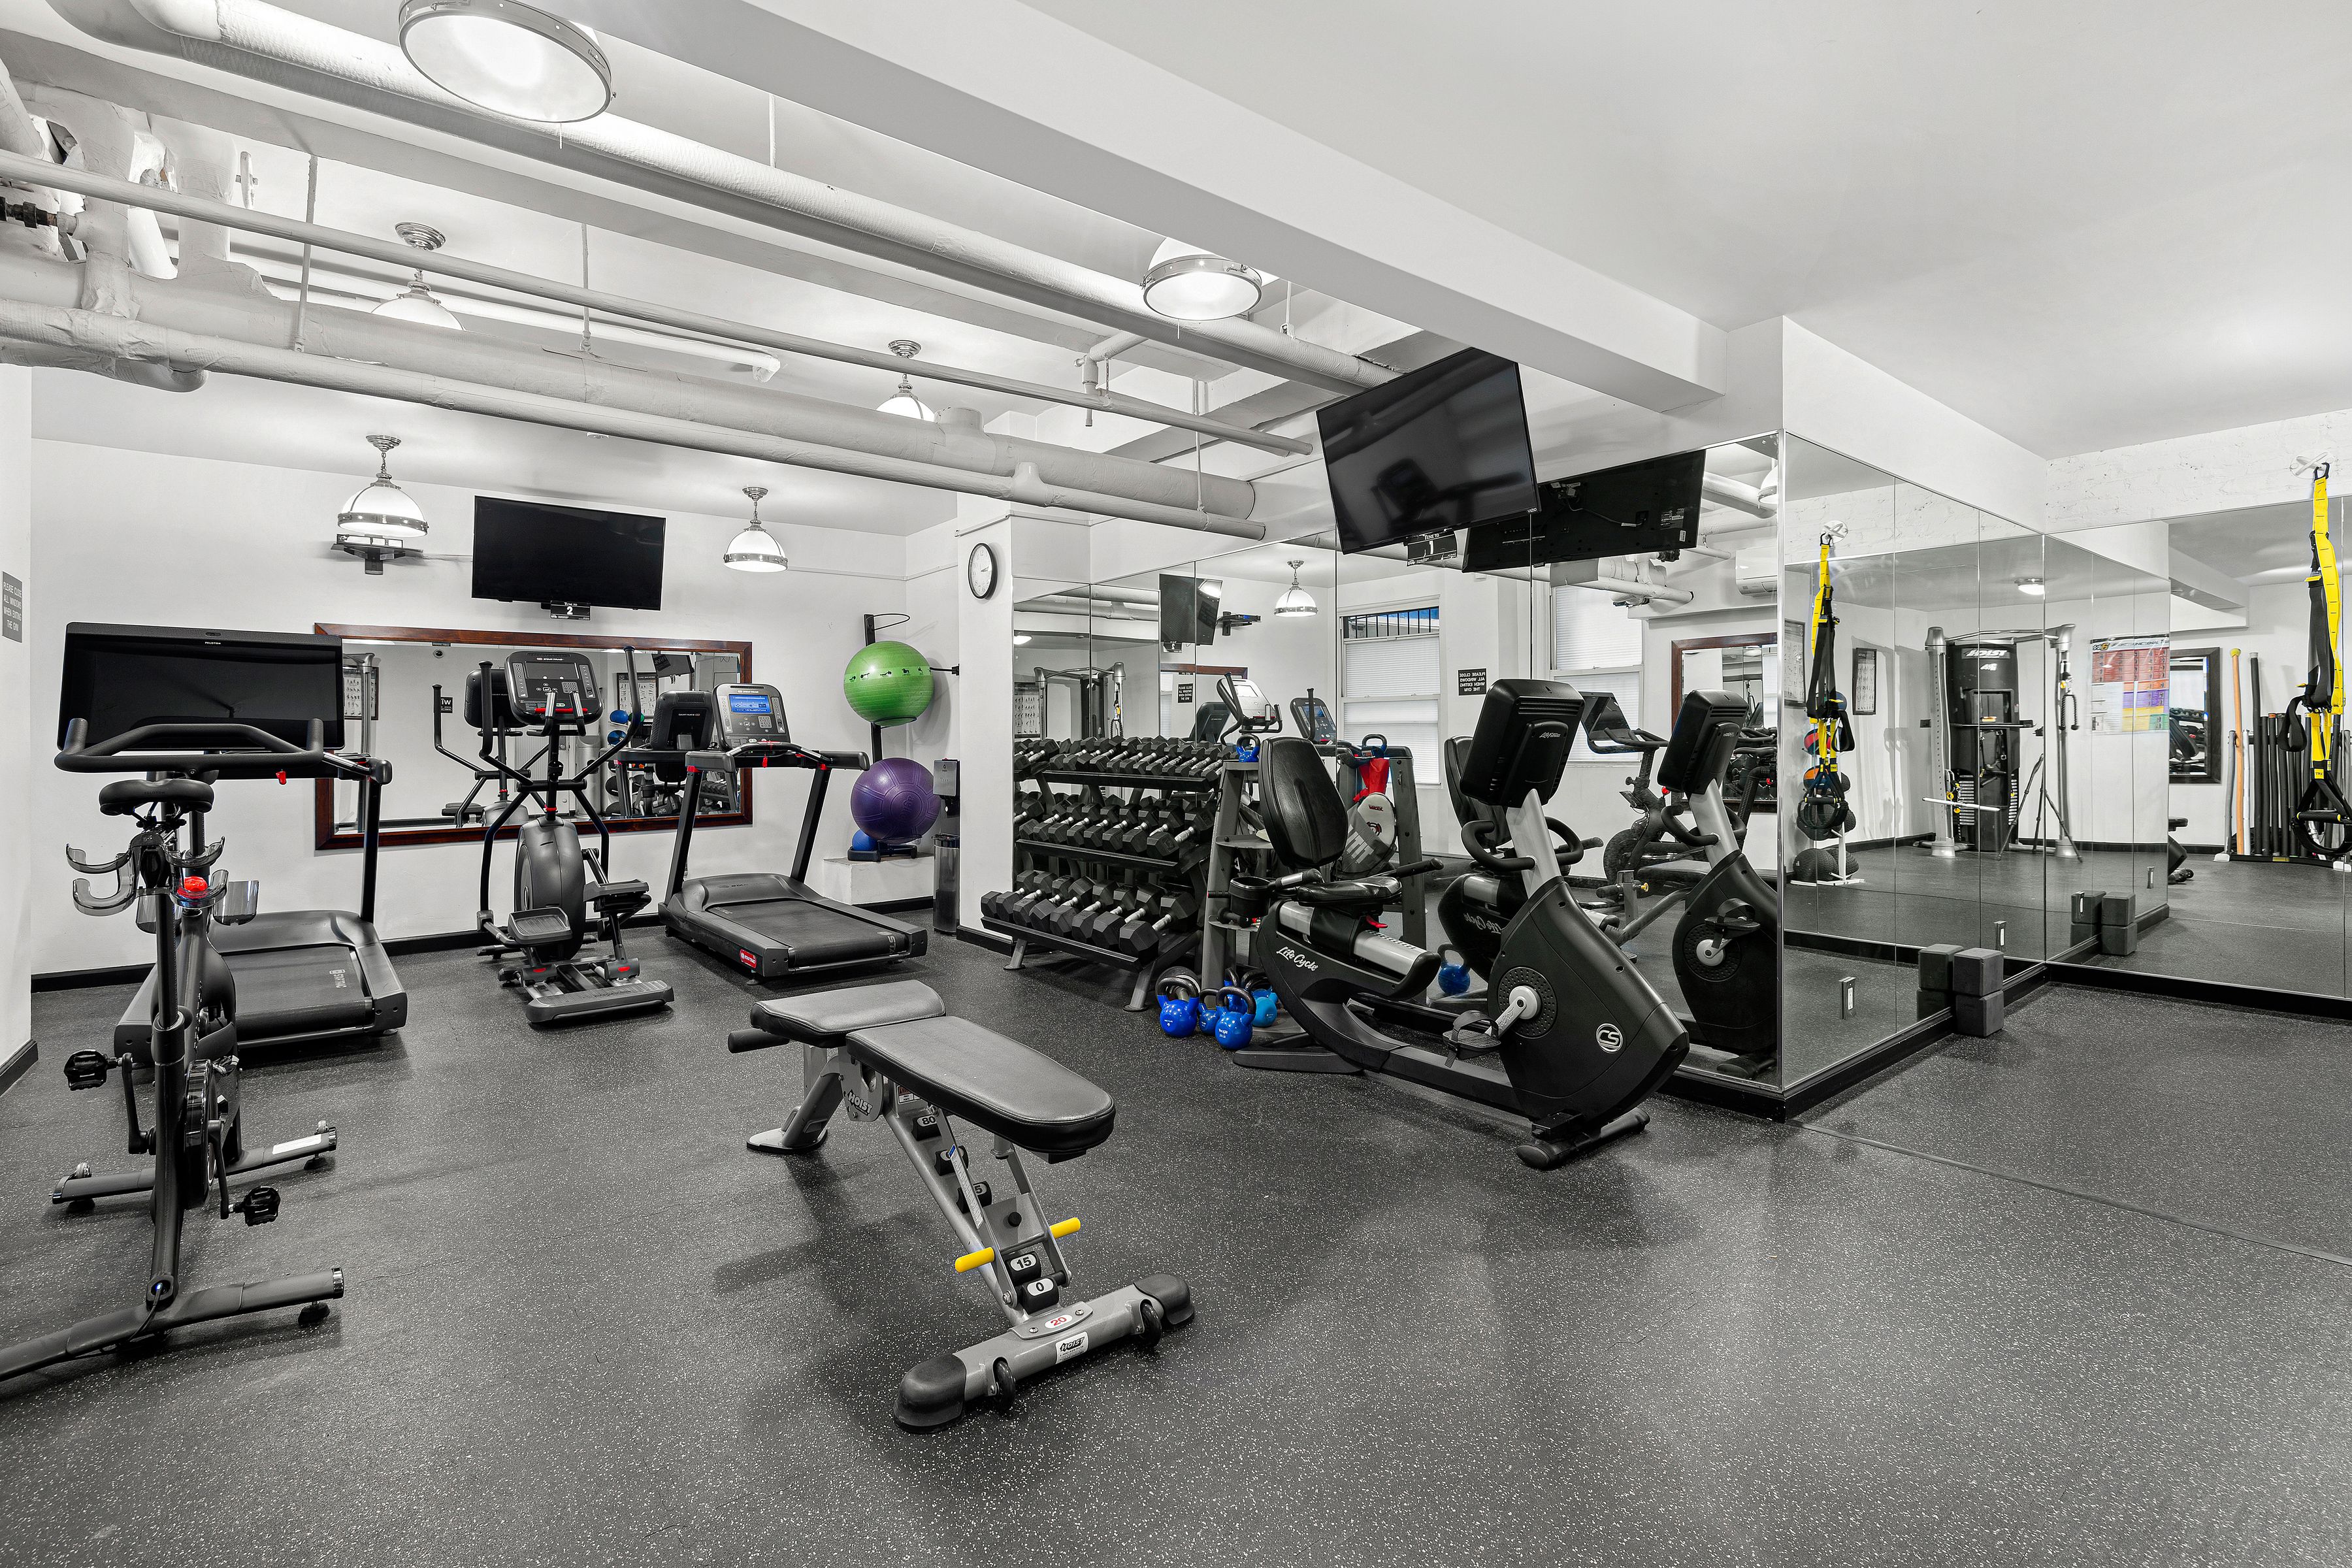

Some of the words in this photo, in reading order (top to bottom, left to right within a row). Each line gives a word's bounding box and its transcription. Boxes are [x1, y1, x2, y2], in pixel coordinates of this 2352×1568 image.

[1429, 540, 1433, 555] 1
[3, 581, 13, 594] PLEASE
[10, 596, 22, 610] WINDOWS
[3, 606, 12, 617] WHEN
[12, 610, 22, 621] EXITING
[566, 606, 573, 615] 2
[1597, 1030, 1621, 1045] CS
[848, 1090, 873, 1114] HOIST
[922, 1116, 936, 1124] 80
[975, 1185, 983, 1194] 5
[1017, 1256, 1032, 1268] 15
[1036, 1282, 1045, 1292] 0
[1050, 1316, 1067, 1326] 20
[1060, 1336, 1085, 1352] HOIST
